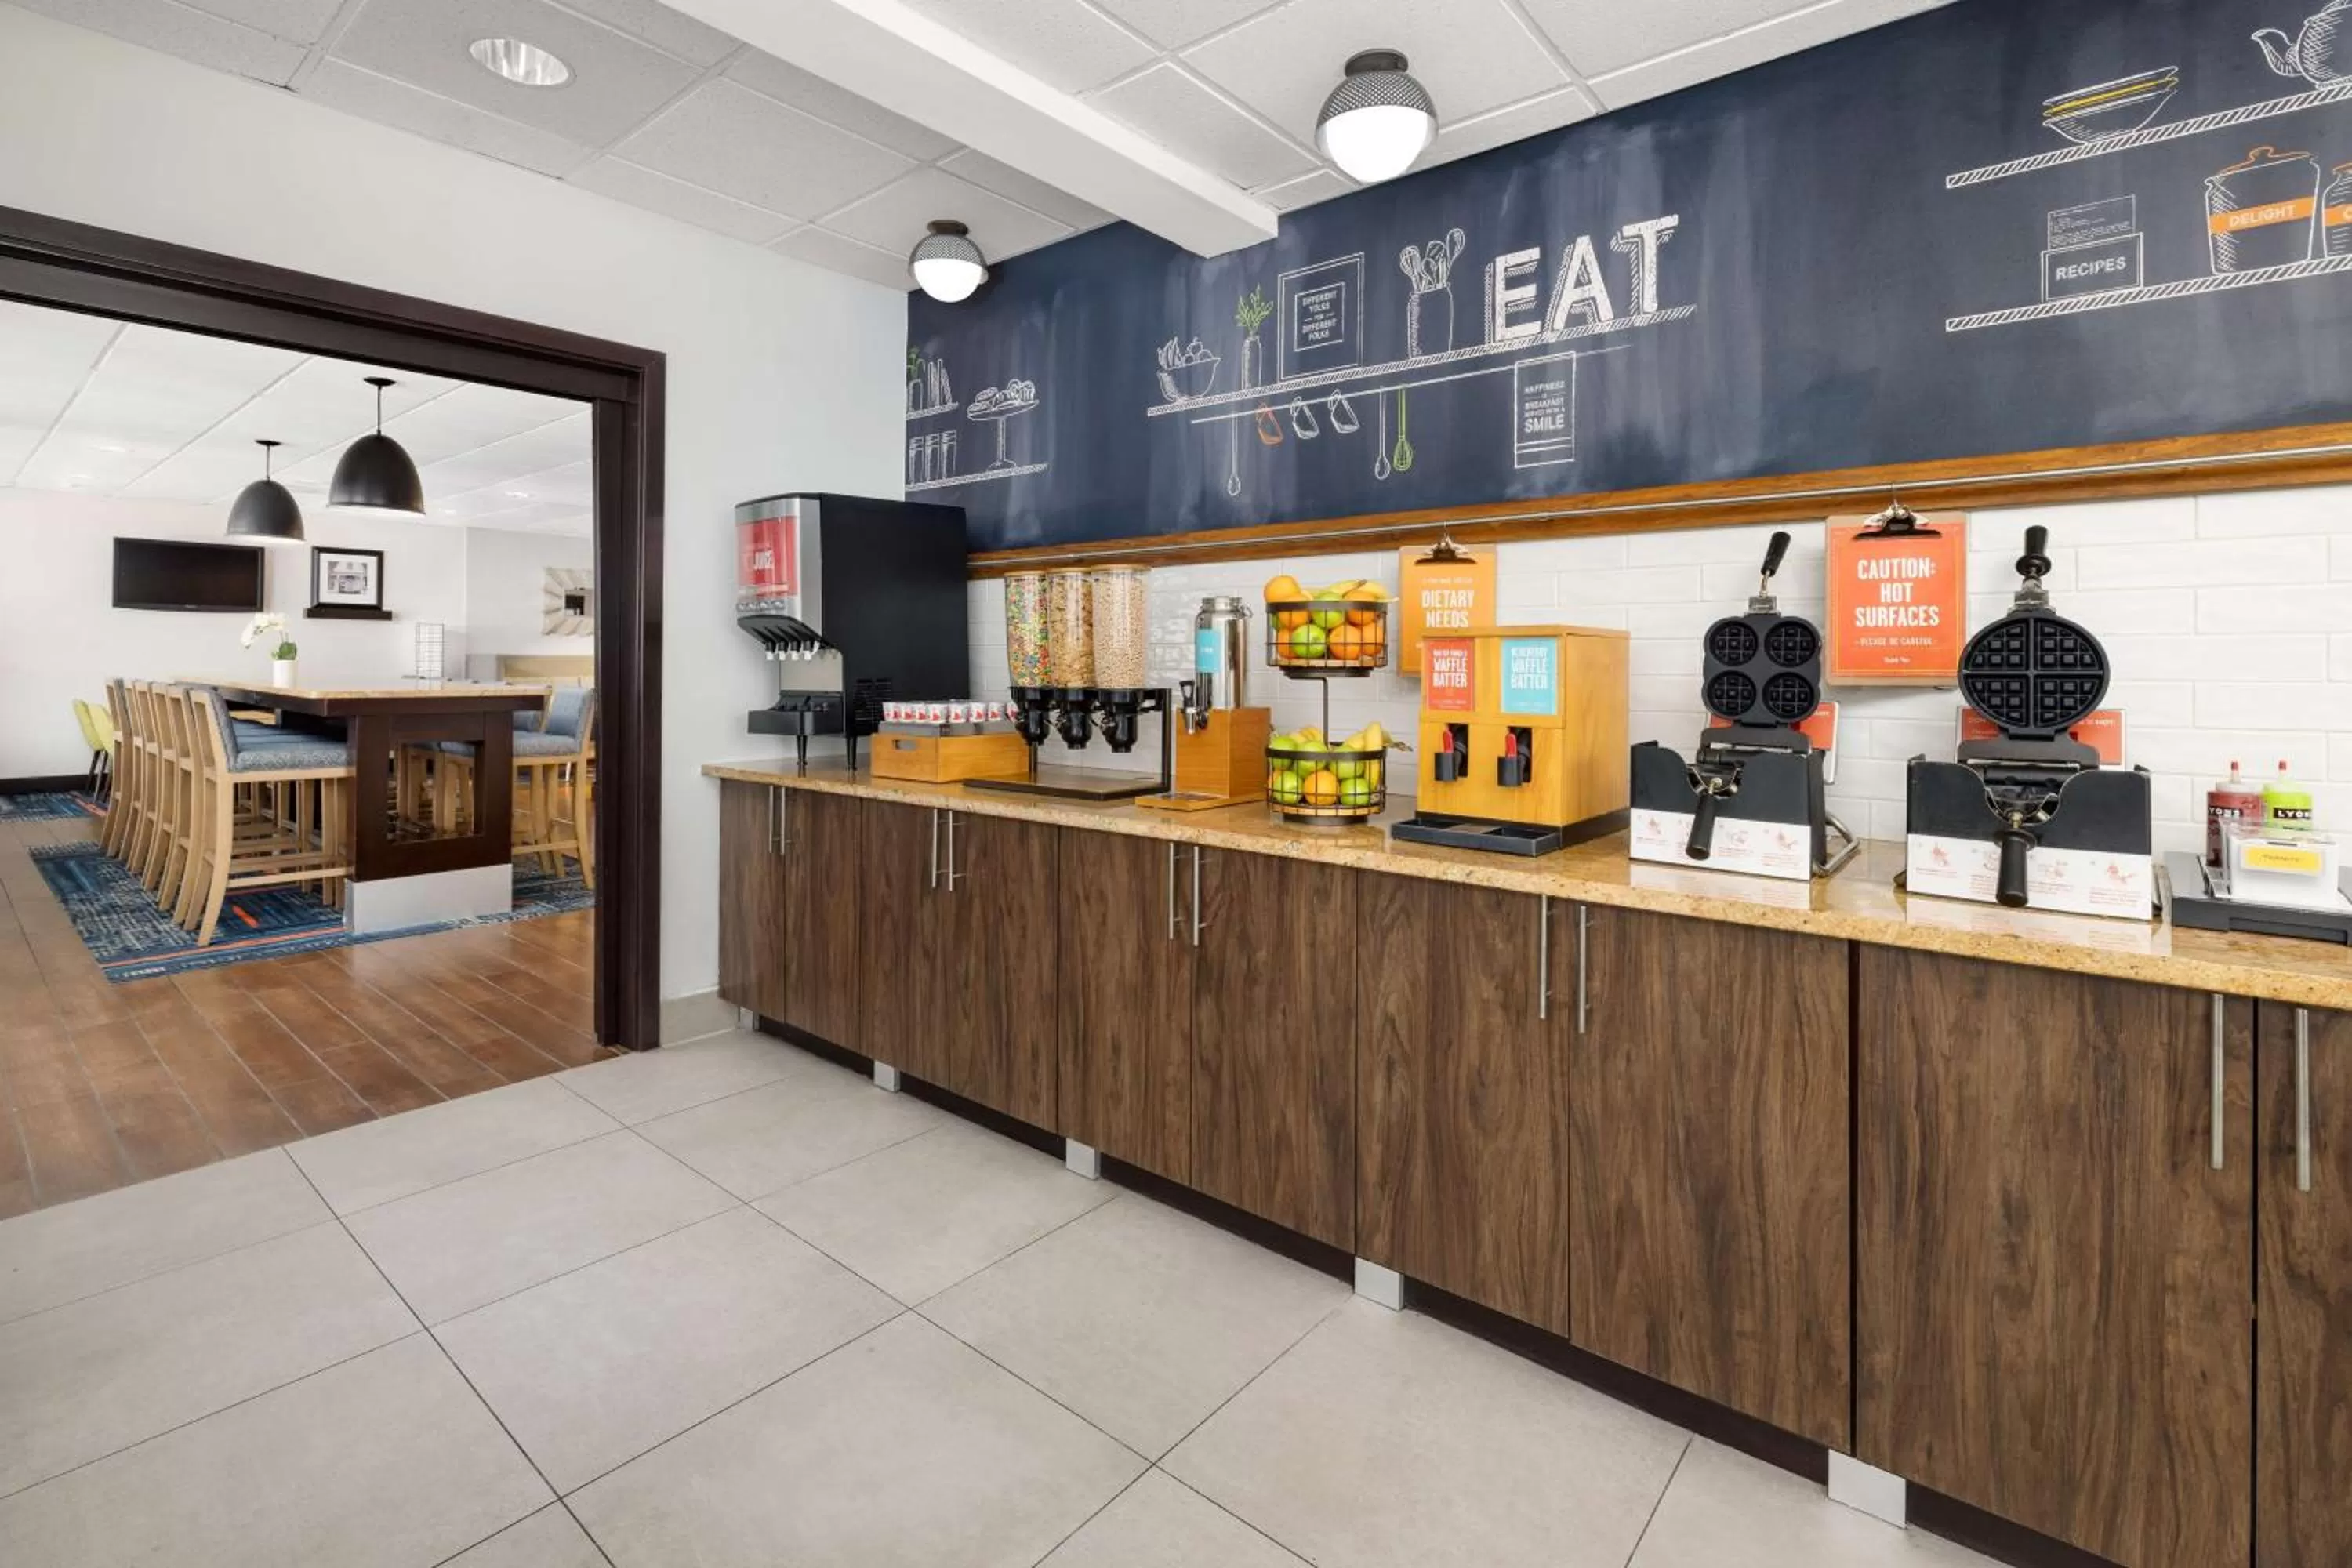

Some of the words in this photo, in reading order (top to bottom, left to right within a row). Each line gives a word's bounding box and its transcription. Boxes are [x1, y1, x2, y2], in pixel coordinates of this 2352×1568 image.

[2229, 205, 2296, 227] DELIGHT
[2056, 256, 2127, 281] RECIPES
[1486, 214, 1679, 344] EAT
[1302, 289, 1338, 307] DIFFERENT
[1302, 318, 1338, 334] DIFFERENT
[1524, 381, 1565, 393] HAPPINESS
[1525, 397, 1564, 410] BREAKFAST
[1524, 414, 1566, 434] SMILE
[1857, 557, 1937, 580] CAUTION:
[1421, 589, 1475, 608] DIETARY
[1880, 582, 1914, 603] HOT
[1426, 609, 1469, 628] NEEDS
[1855, 605, 1940, 628] SURFACES
[1859, 637, 1886, 647] PLEASE
[1433, 658, 1468, 672] WAFFLE
[1512, 658, 1548, 673] WAFFLE
[1432, 672, 1468, 688] BATTER
[1511, 673, 1548, 690] BATTER
[2209, 806, 2241, 818] YONS
